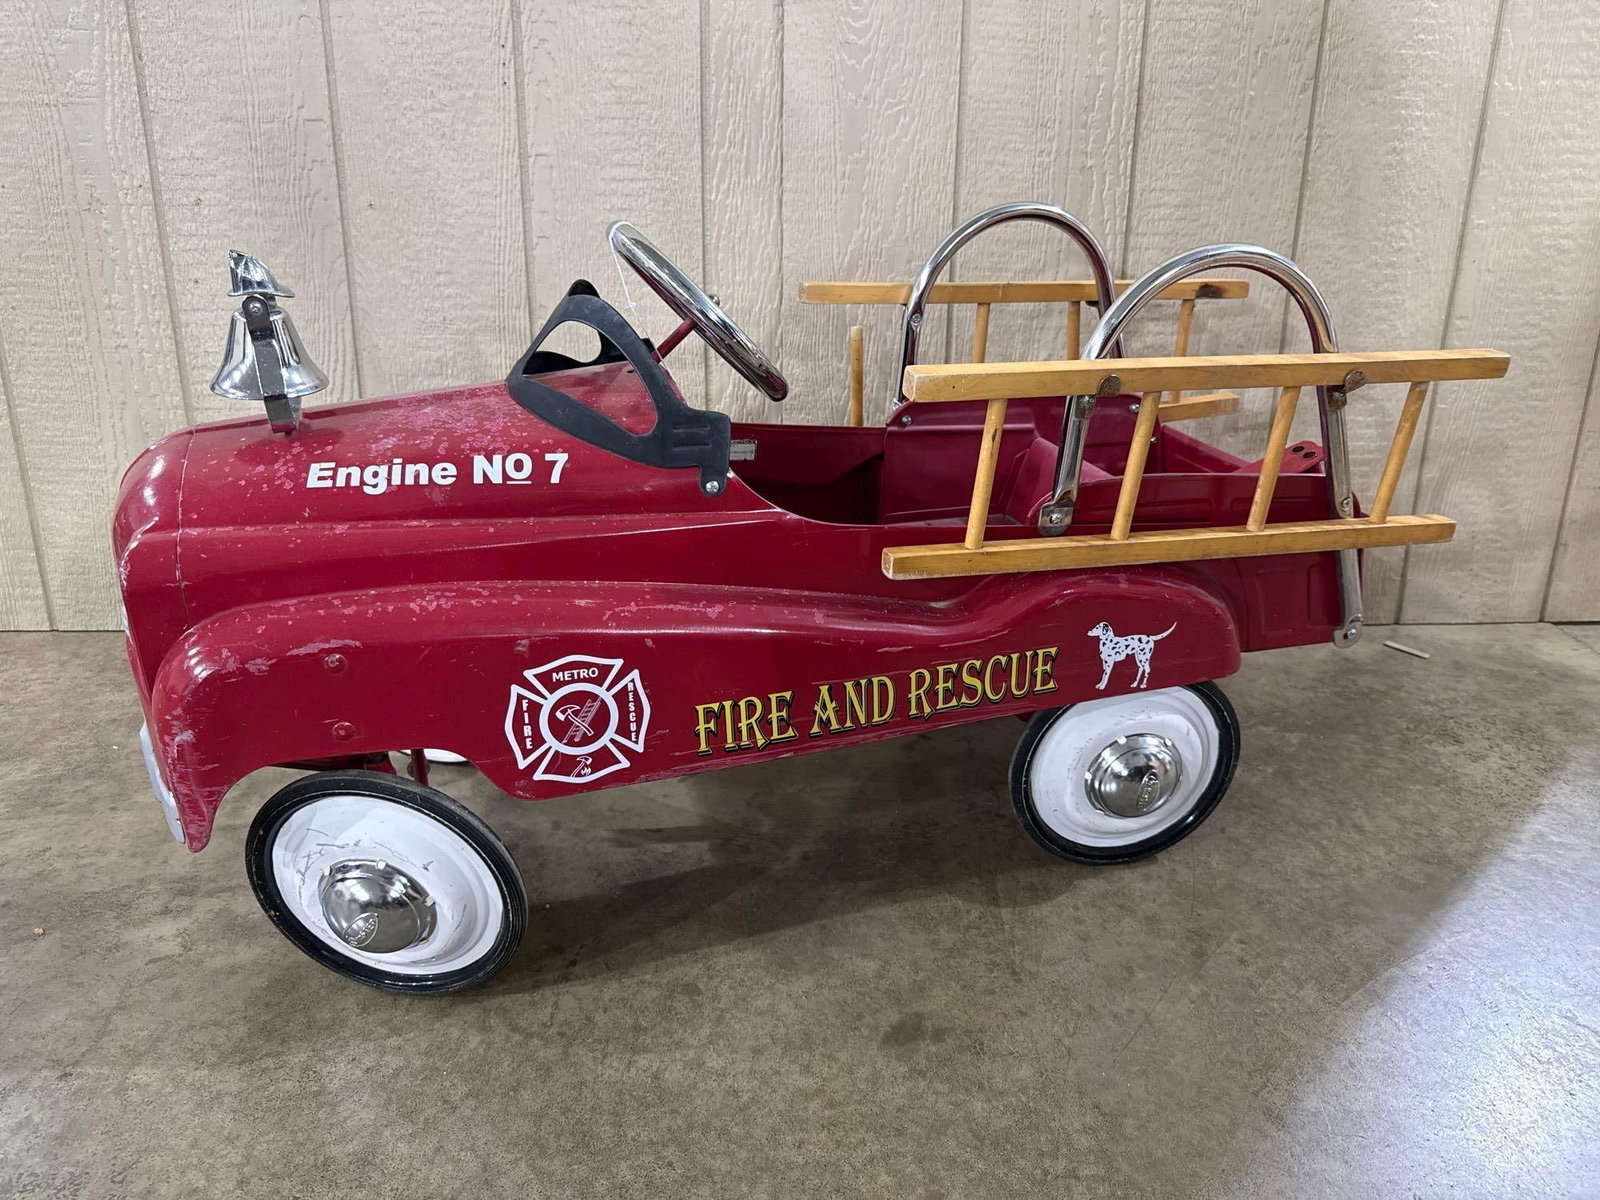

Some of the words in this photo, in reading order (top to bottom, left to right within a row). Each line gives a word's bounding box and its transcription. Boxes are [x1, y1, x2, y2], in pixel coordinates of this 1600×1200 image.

[306, 458, 457, 495] Engine
[545, 453, 569, 484] 7
[552, 667, 599, 683] METRO
[522, 699, 533, 750] FIRE
[627, 682, 637, 742] RESCUE
[694, 691, 798, 757] FIRE
[808, 675, 896, 738] AND
[908, 646, 1060, 721] RESCUE
